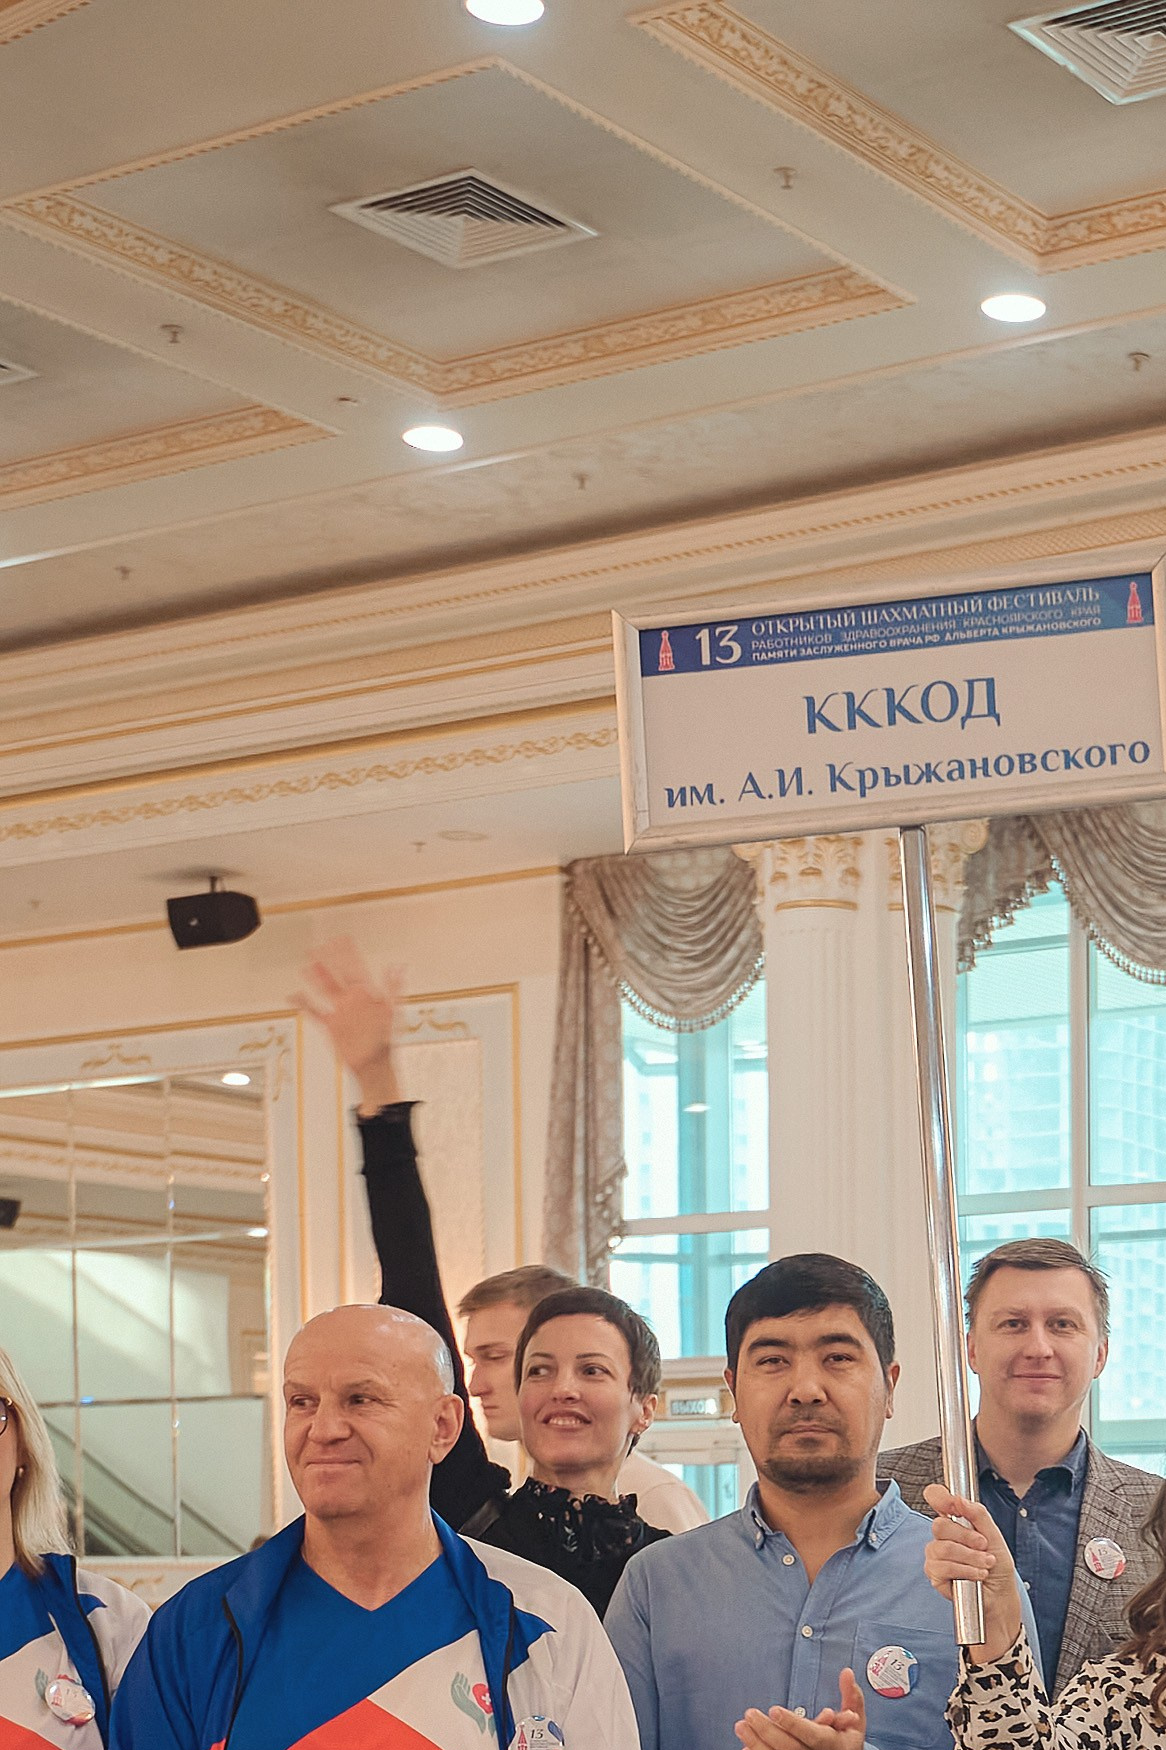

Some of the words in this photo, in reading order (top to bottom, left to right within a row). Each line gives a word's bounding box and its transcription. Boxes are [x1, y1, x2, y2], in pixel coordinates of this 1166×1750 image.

[752, 609, 856, 636] ОТКРЫТЫЙ
[861, 598, 983, 626] ШАХМАТНЫЙ
[987, 587, 1100, 612] ФЕСТИВАЛЬ
[752, 633, 832, 650] РАБОТНИКОВ
[842, 619, 956, 642] ЗДРАВООХРАНЕНИЯ
[963, 609, 1063, 628] КРАСНОЯРСКОГО
[695, 625, 742, 666] 13
[752, 649, 797, 662] ПАМЯТИ
[800, 640, 887, 657] ЗАСЛУЖЕННОГО
[889, 636, 923, 648] ВРАЧА
[925, 634, 940, 644] РФ
[945, 627, 999, 641] АЛЬБЕРТА
[1001, 617, 1101, 634] КРЫЖАНОВСКОГО
[803, 677, 1001, 734] КККОД
[663, 783, 725, 808] им.
[738, 767, 813, 801] А.И.
[826, 740, 1151, 798] Крыжановского
